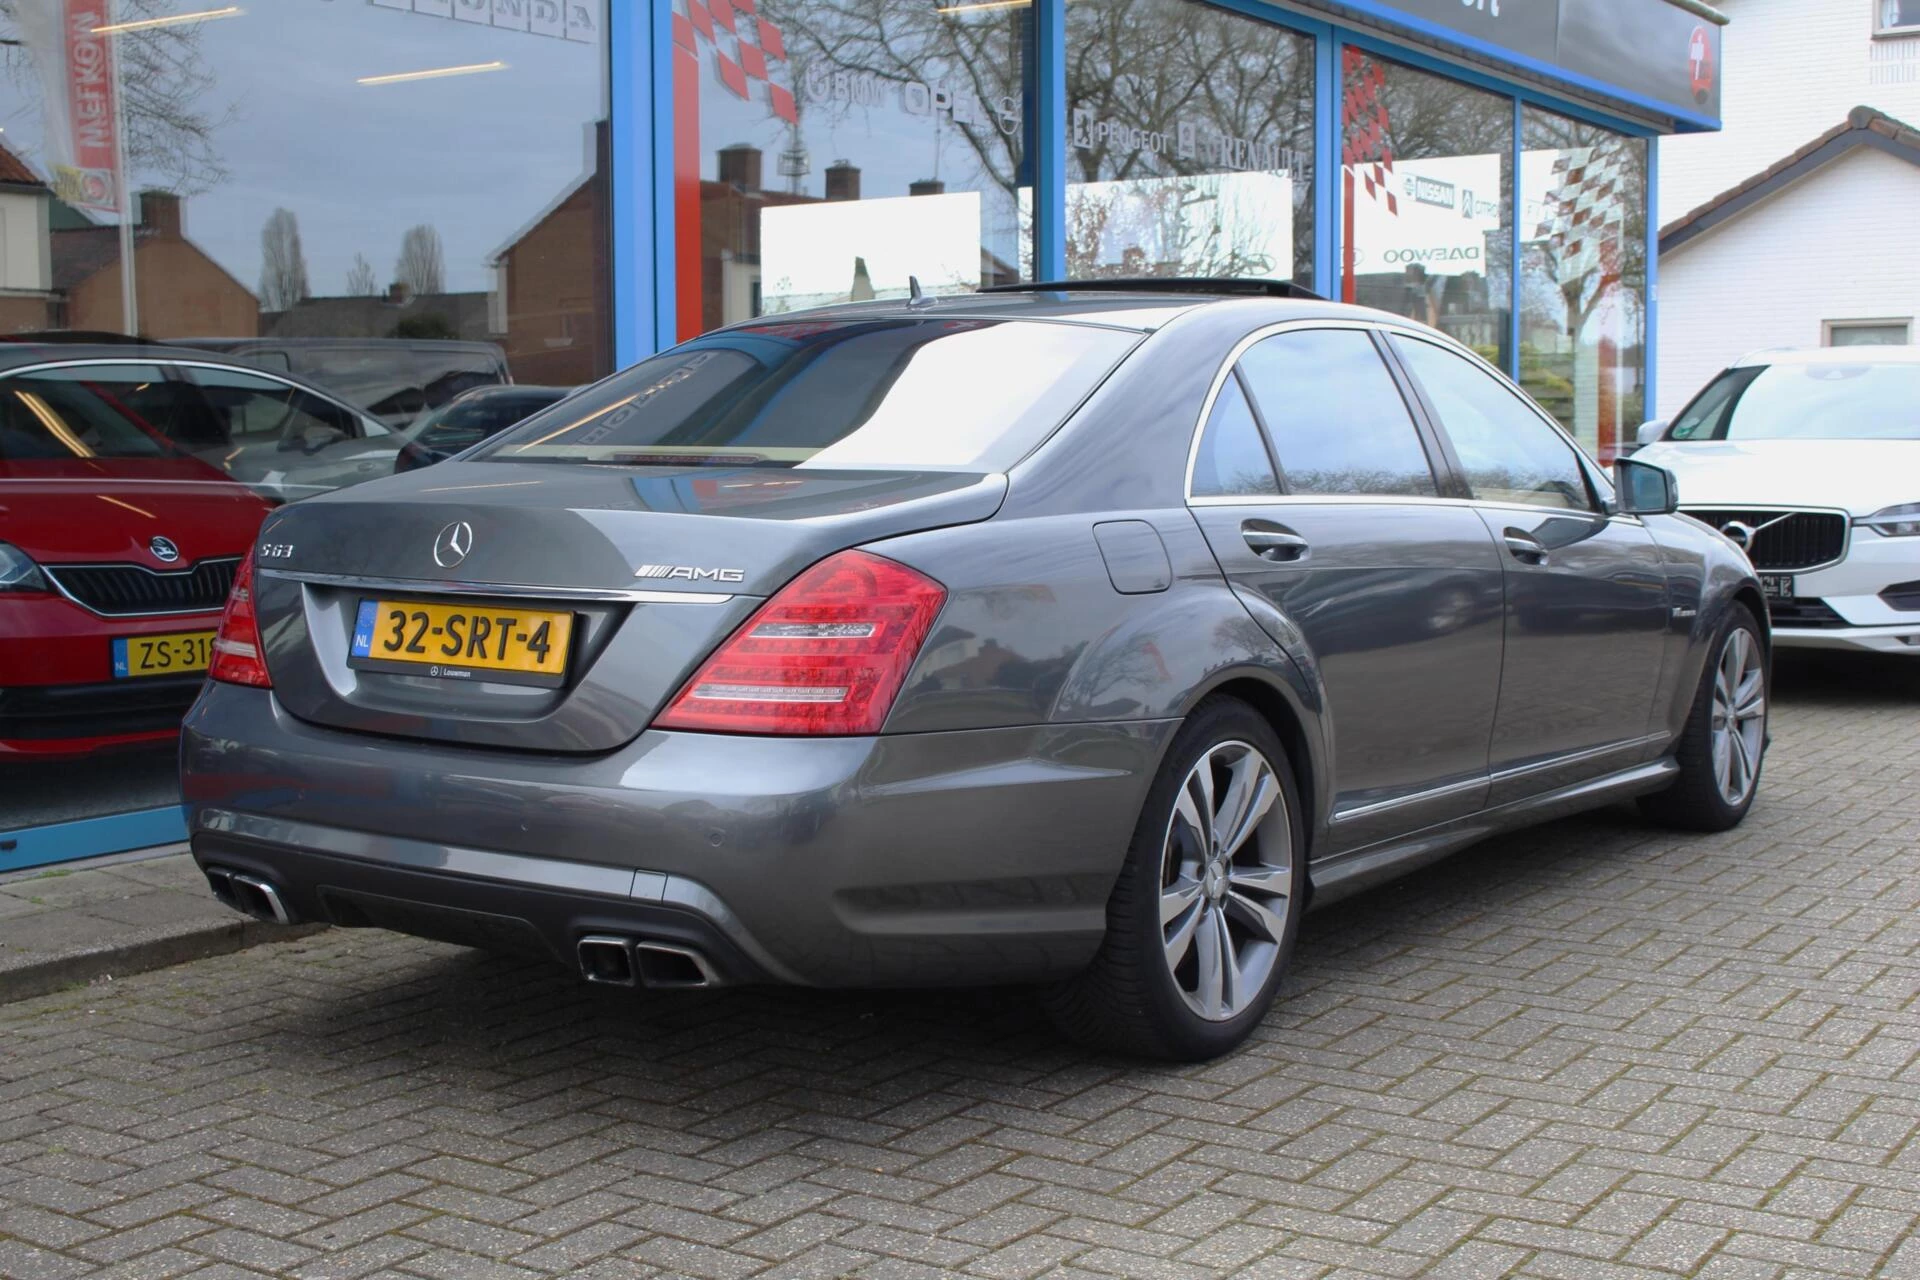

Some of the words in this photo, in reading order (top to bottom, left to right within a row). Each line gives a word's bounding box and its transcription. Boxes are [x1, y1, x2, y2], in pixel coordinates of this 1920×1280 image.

[1098, 121, 1169, 154] PEUGEOT
[1417, 178, 1455, 208] NISSAN
[668, 566, 745, 583] AMG
[356, 633, 370, 649] NL
[383, 610, 551, 664] 32-SRT-4
